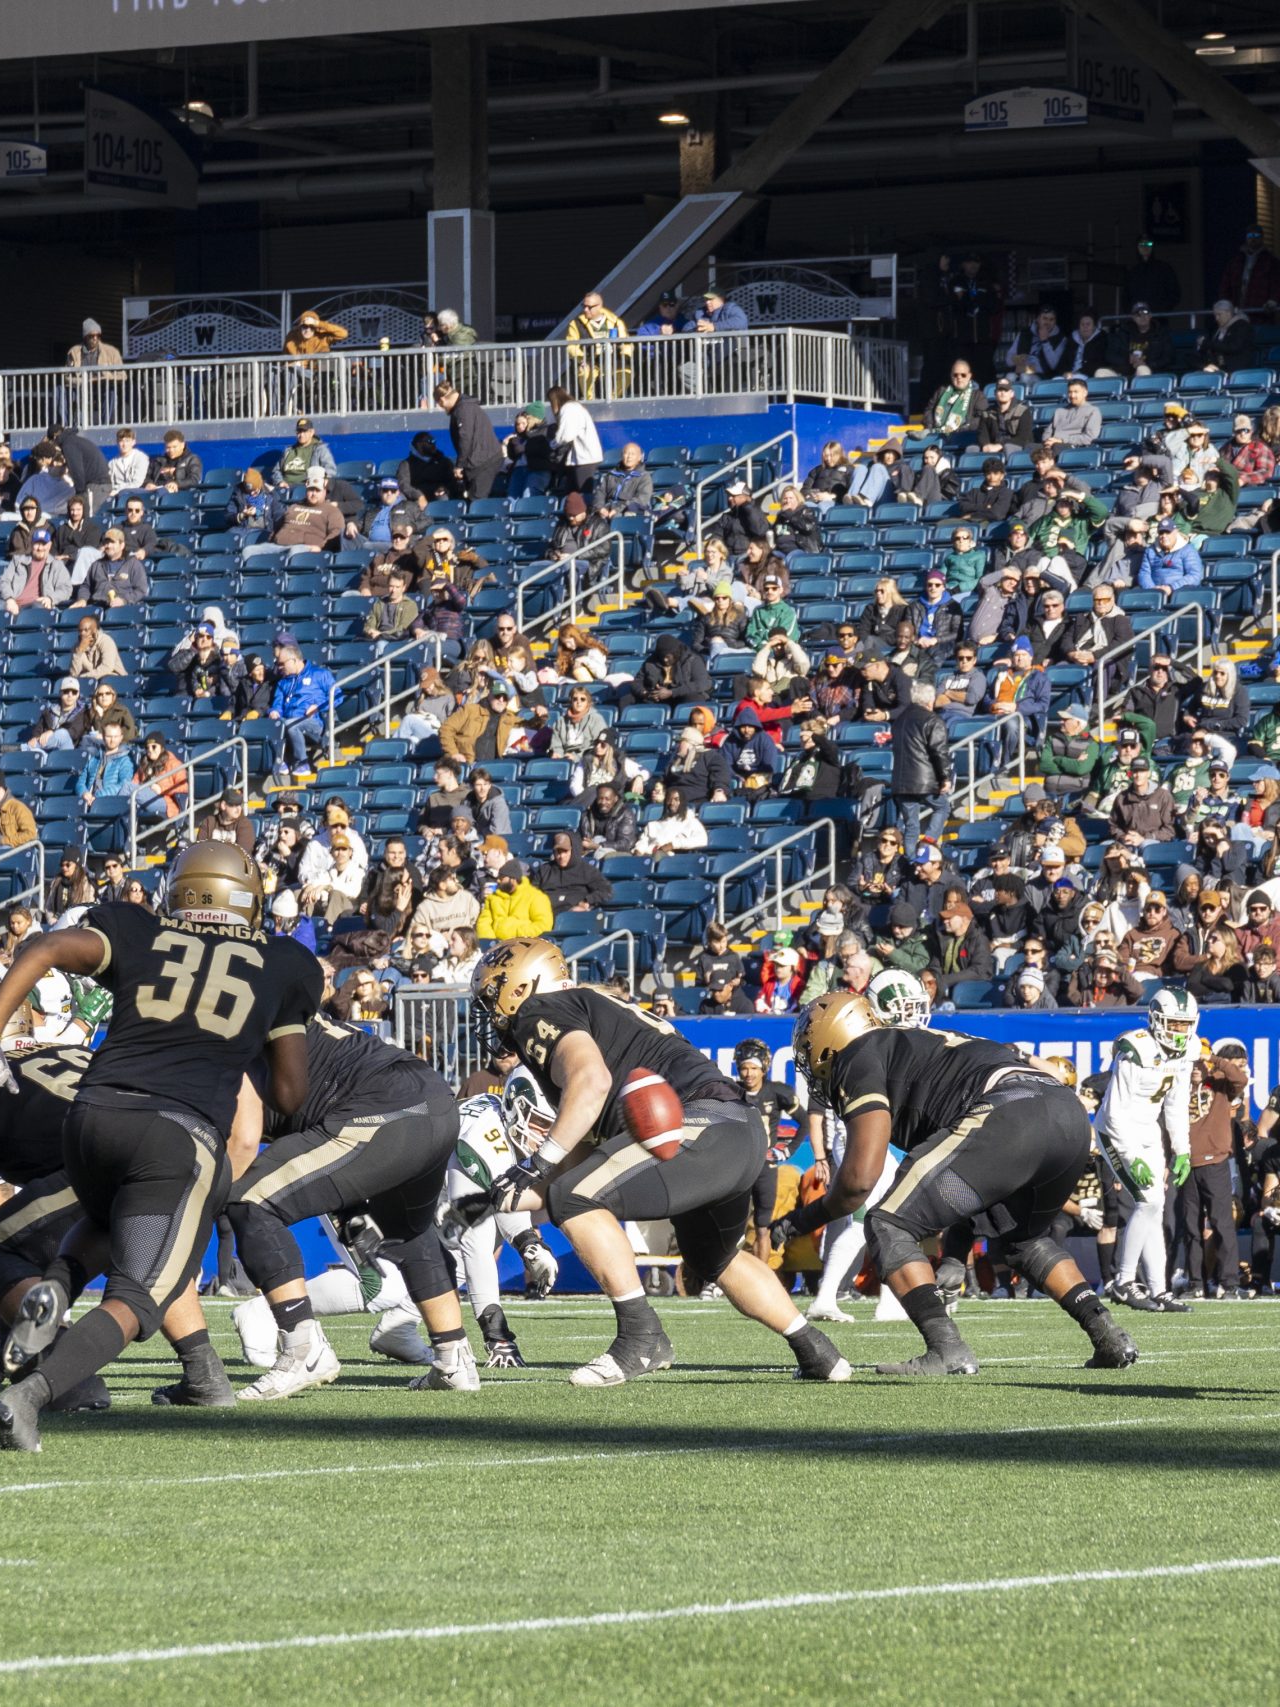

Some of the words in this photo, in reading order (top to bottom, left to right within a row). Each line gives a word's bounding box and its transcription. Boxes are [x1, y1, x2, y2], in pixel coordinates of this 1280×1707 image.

[982, 101, 1009, 122] 105
[1043, 97, 1071, 117] 106
[6, 150, 31, 169] 105
[92, 131, 164, 175] 104-105
[194, 324, 216, 346] W
[201, 894, 213, 905] 36
[184, 911, 228, 922] Riddell
[136, 930, 265, 1040] 36
[525, 1018, 562, 1065] 64
[352, 1114, 386, 1124] MANITOBA
[192, 1126, 218, 1151] MANITOBA
[484, 1127, 510, 1155] 97
